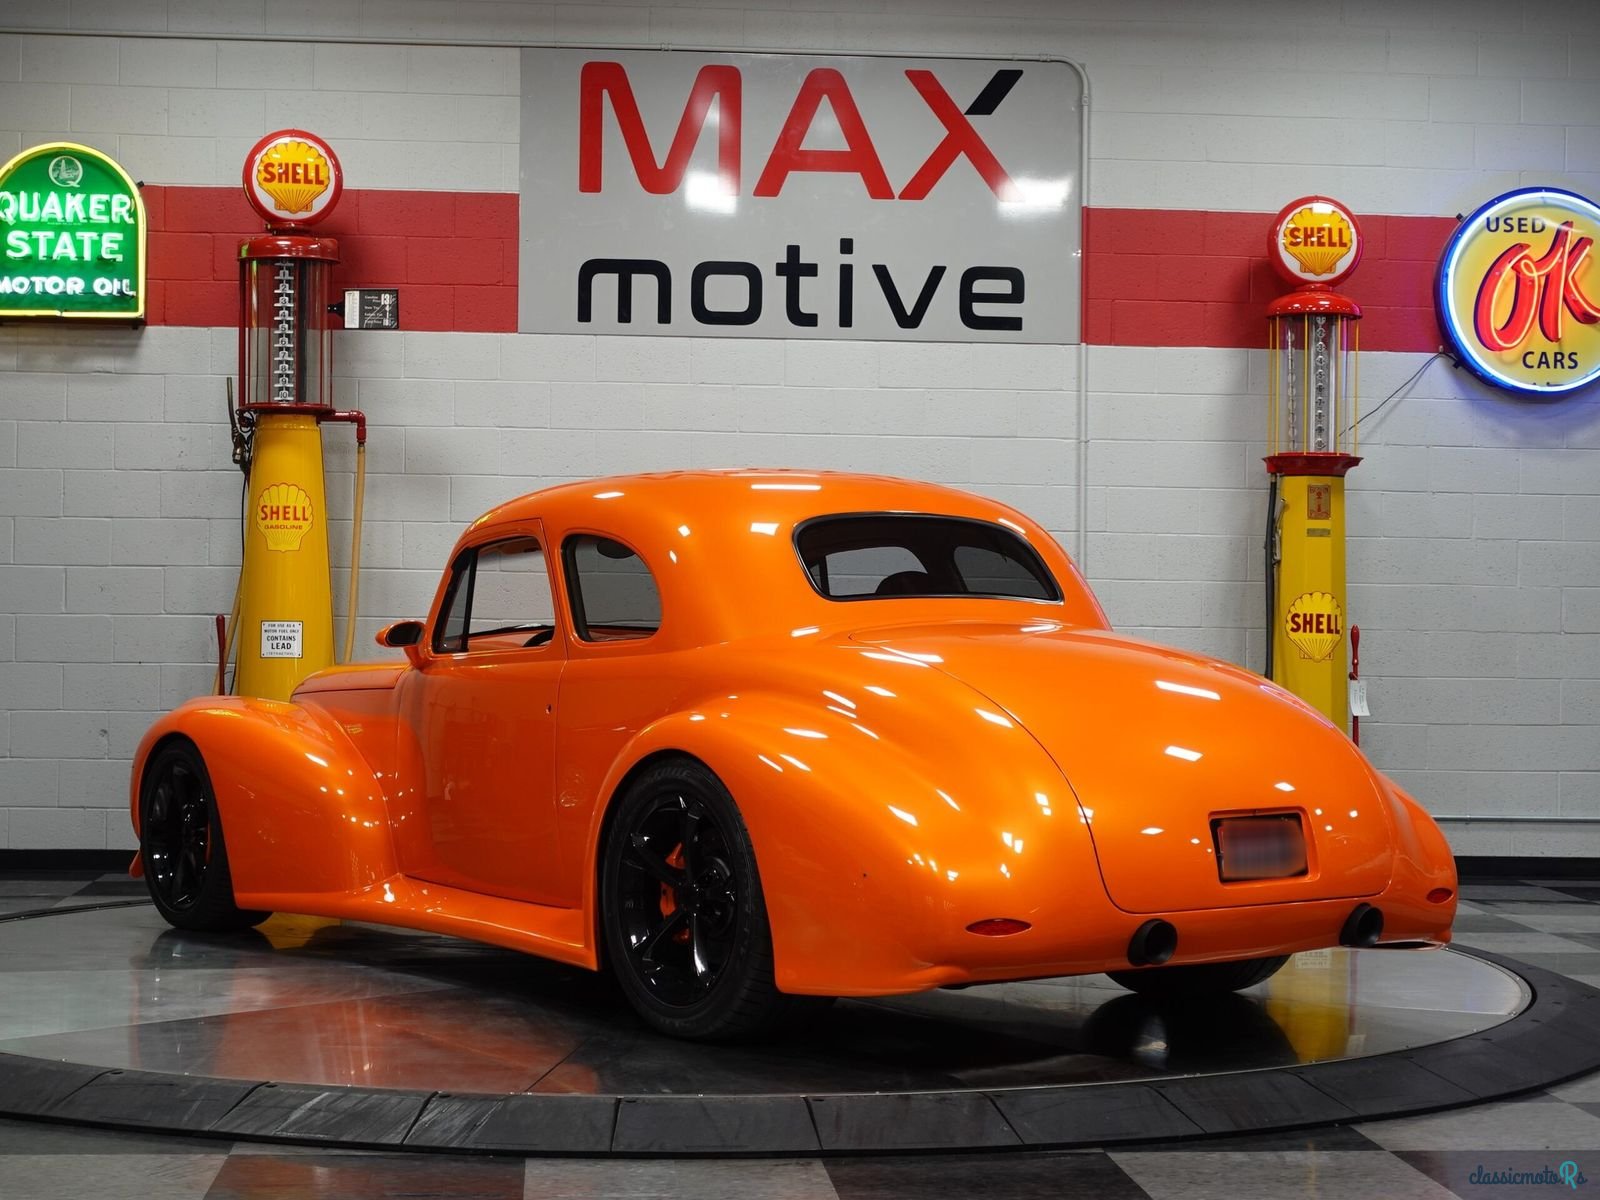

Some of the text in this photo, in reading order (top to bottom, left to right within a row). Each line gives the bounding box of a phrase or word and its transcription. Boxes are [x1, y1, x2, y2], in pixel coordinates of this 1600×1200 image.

[579, 61, 1024, 202] MAX
[263, 162, 325, 186] SHELL
[0, 191, 135, 226] QUAKER
[1486, 217, 1546, 234] USED
[6, 230, 123, 262] STATE
[1289, 227, 1348, 248] SHELL
[93, 276, 136, 296] OIL
[577, 238, 1025, 332] motive
[1474, 221, 1600, 351] OK
[1522, 351, 1578, 369] CARS
[261, 505, 309, 521] SHELL
[1290, 613, 1340, 635] SHELL
[271, 642, 292, 650] LEAD
